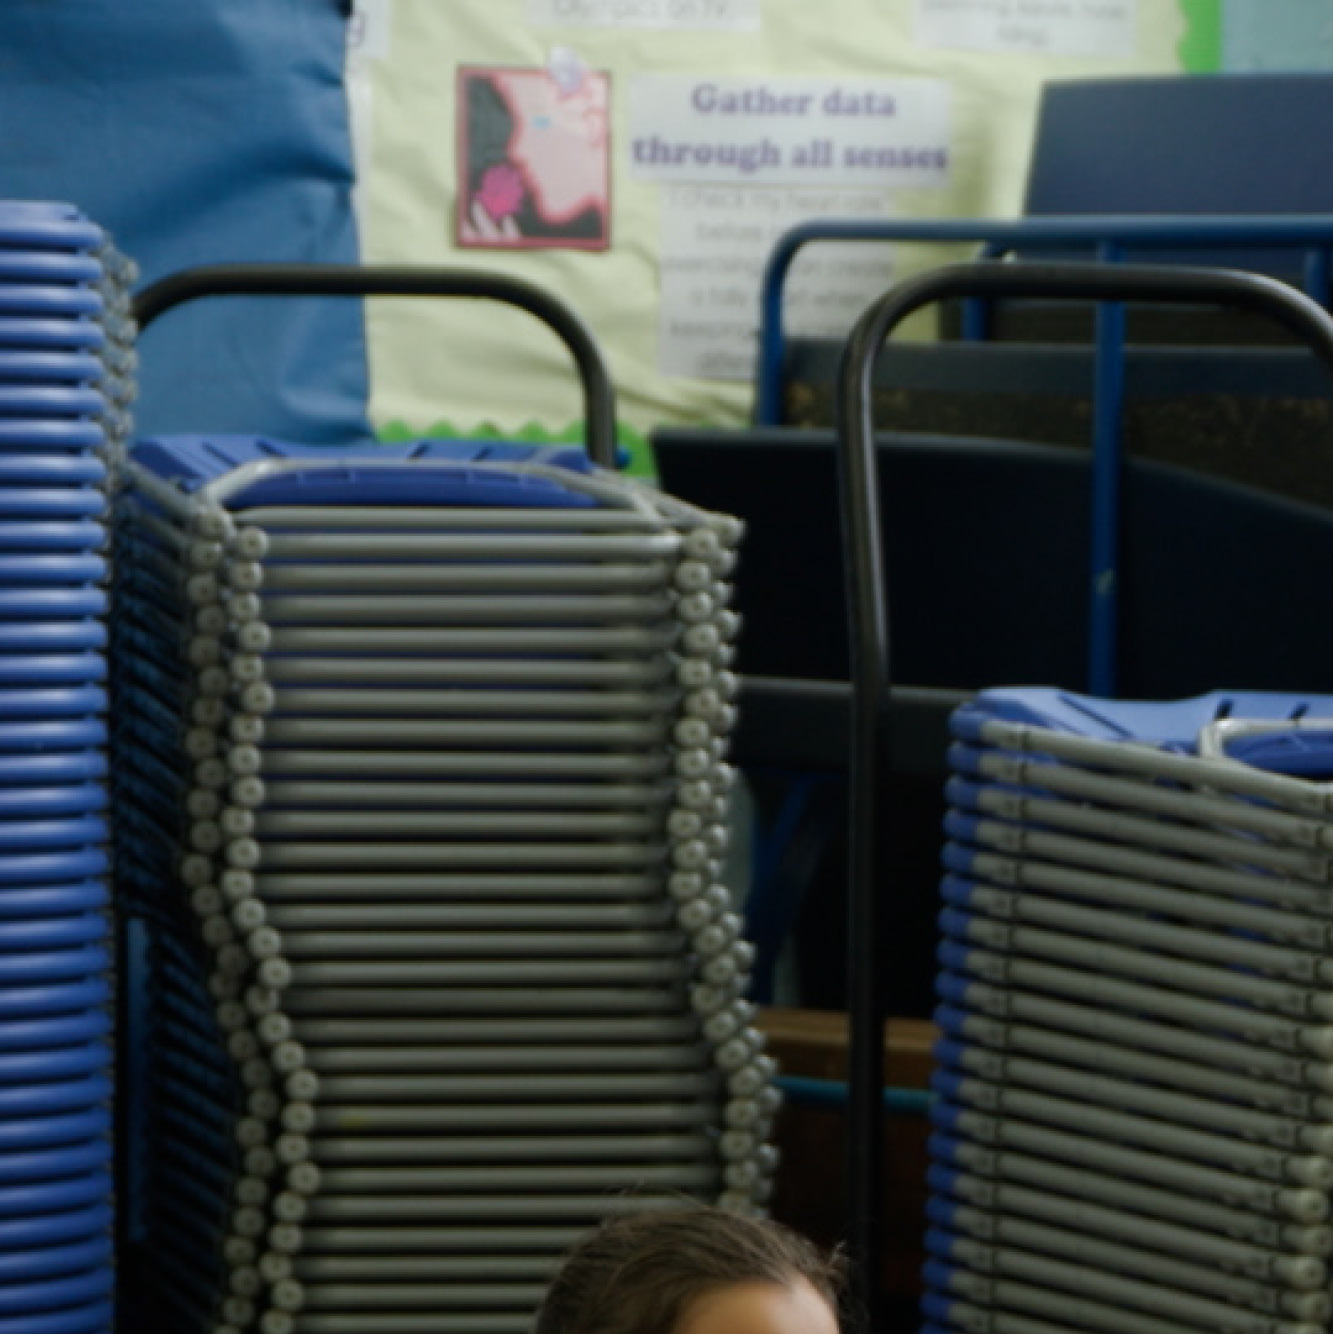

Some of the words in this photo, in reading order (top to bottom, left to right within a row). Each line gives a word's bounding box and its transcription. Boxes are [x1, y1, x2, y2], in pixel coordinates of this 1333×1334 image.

[691, 84, 812, 119] Gather
[822, 85, 898, 119] data
[632, 137, 781, 173] through
[791, 140, 834, 169] all
[843, 144, 949, 170] senses
